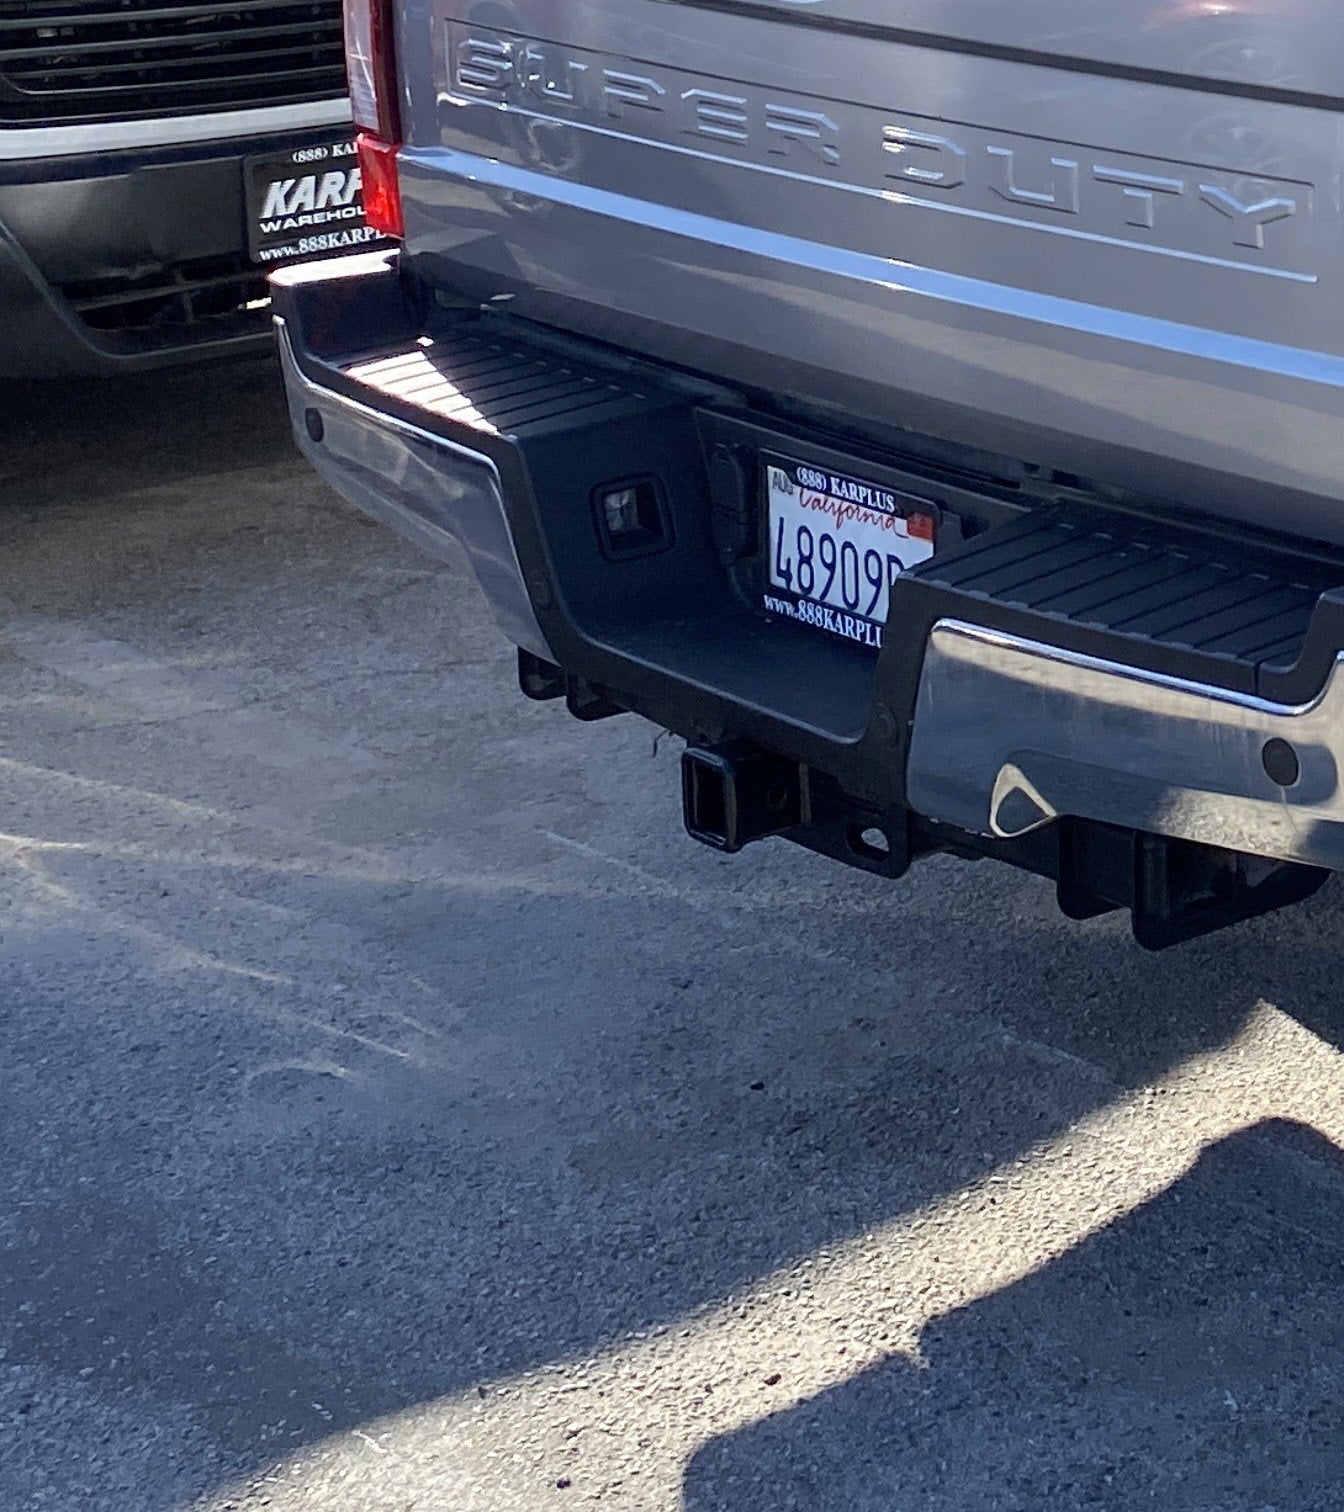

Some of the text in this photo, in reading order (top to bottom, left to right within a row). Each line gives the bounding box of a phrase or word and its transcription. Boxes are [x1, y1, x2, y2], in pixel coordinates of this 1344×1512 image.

[291, 146, 329, 164] (888)
[457, 37, 1297, 249] SUPER DUTY
[796, 466, 896, 513] (888) KARPLUS
[799, 487, 911, 539] California
